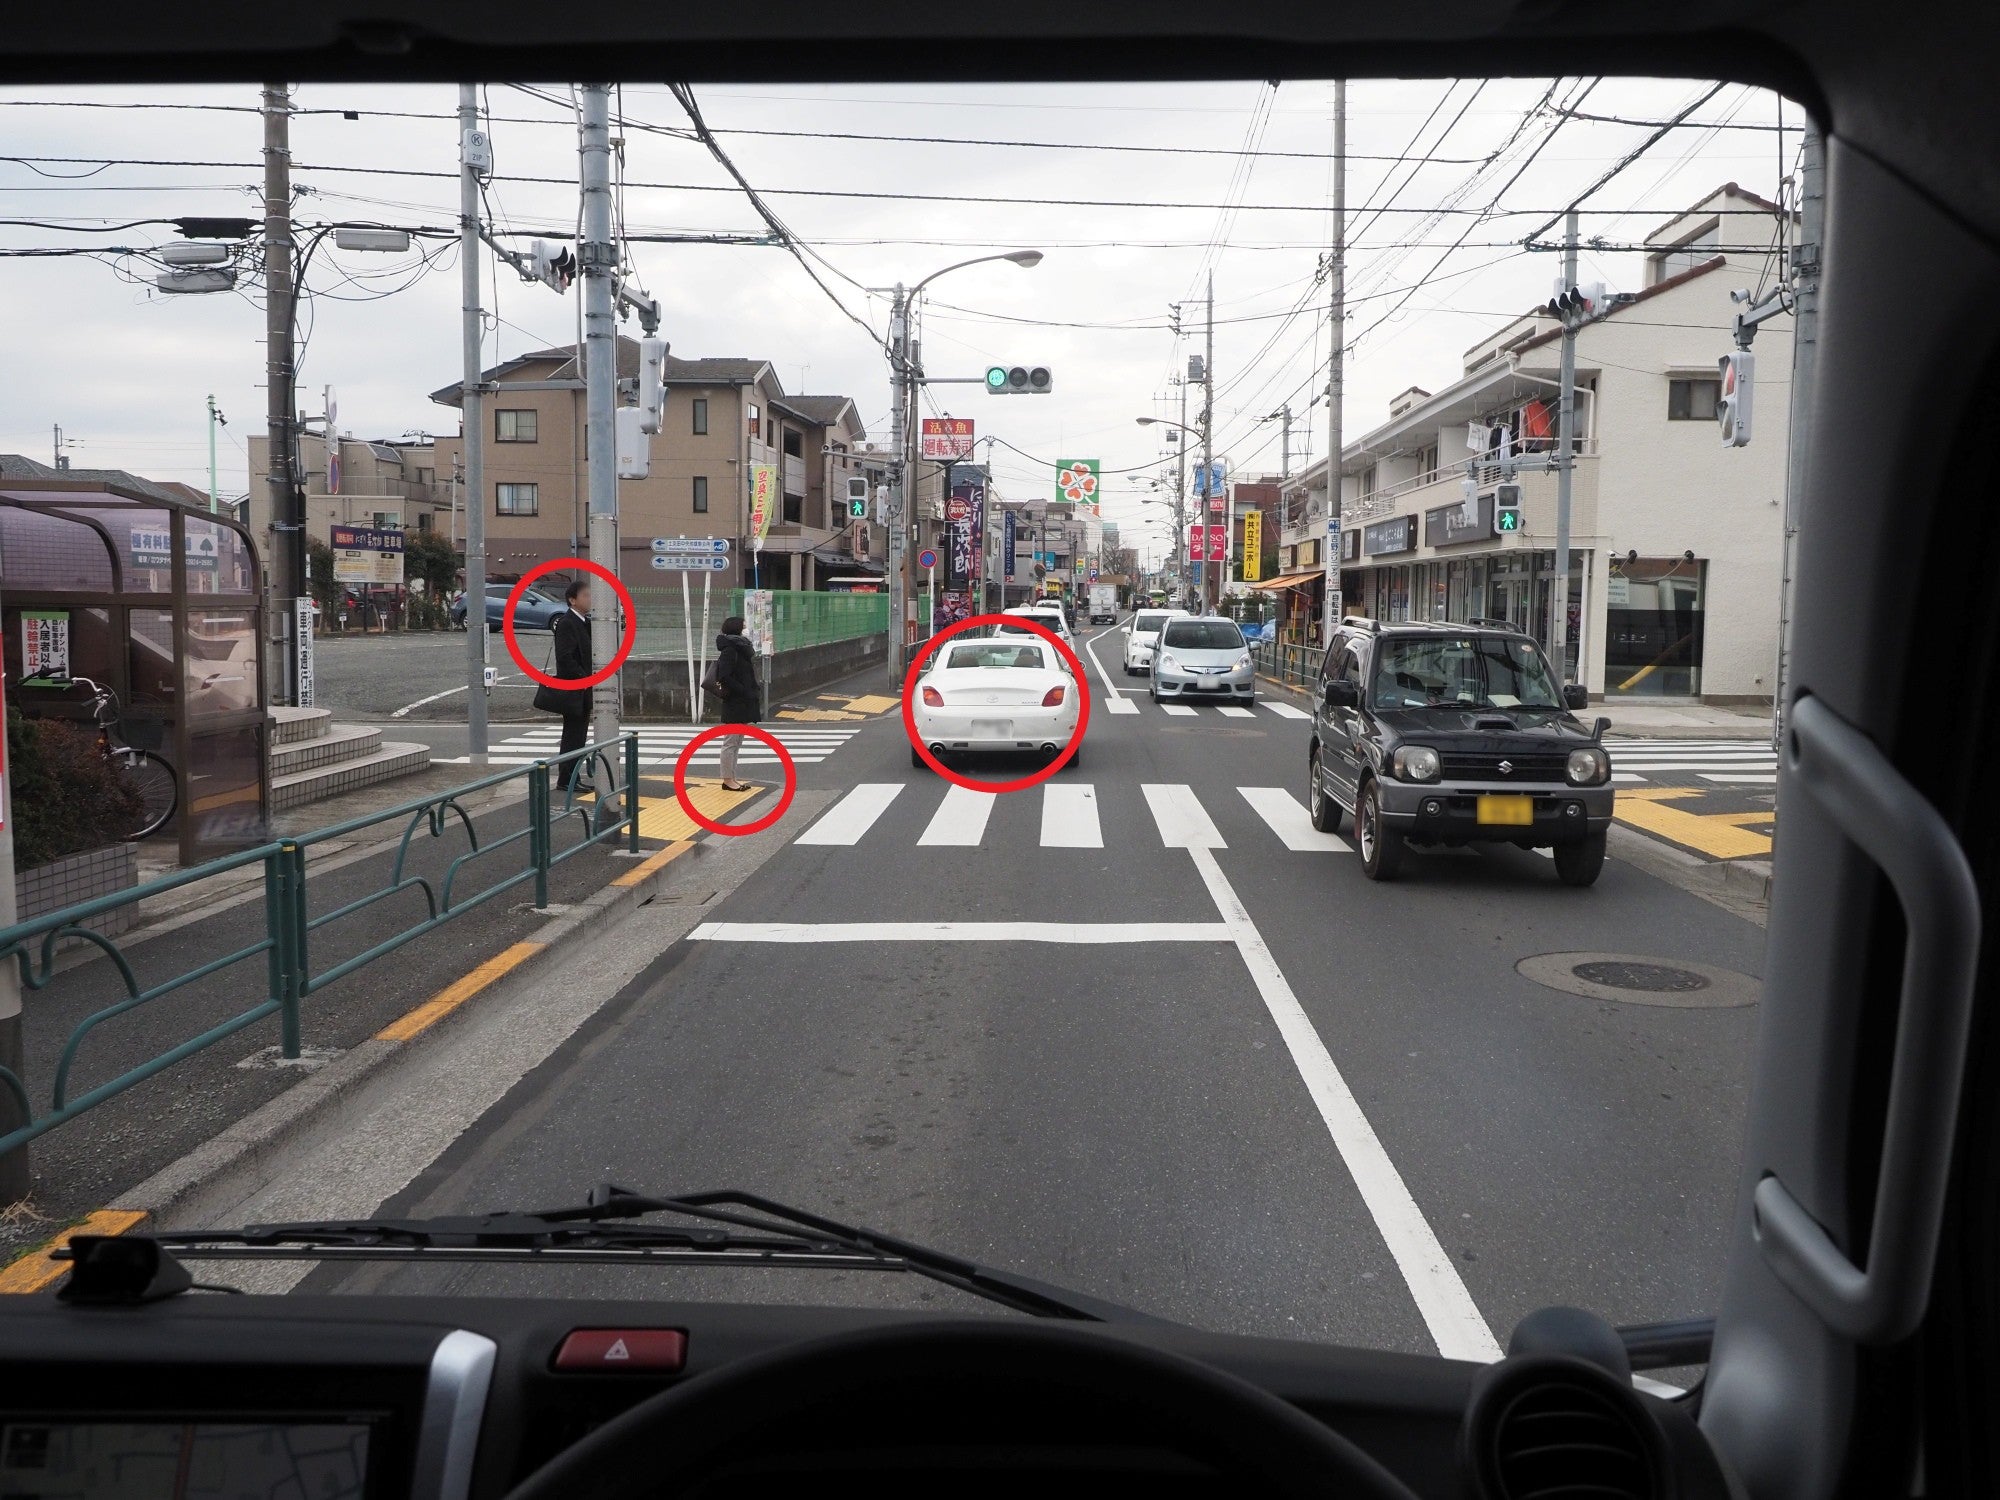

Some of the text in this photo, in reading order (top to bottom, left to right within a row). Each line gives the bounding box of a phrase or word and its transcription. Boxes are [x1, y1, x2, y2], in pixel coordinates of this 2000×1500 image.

[1191, 534, 1224, 542] DASO
[1331, 593, 1340, 624] 自転車は
